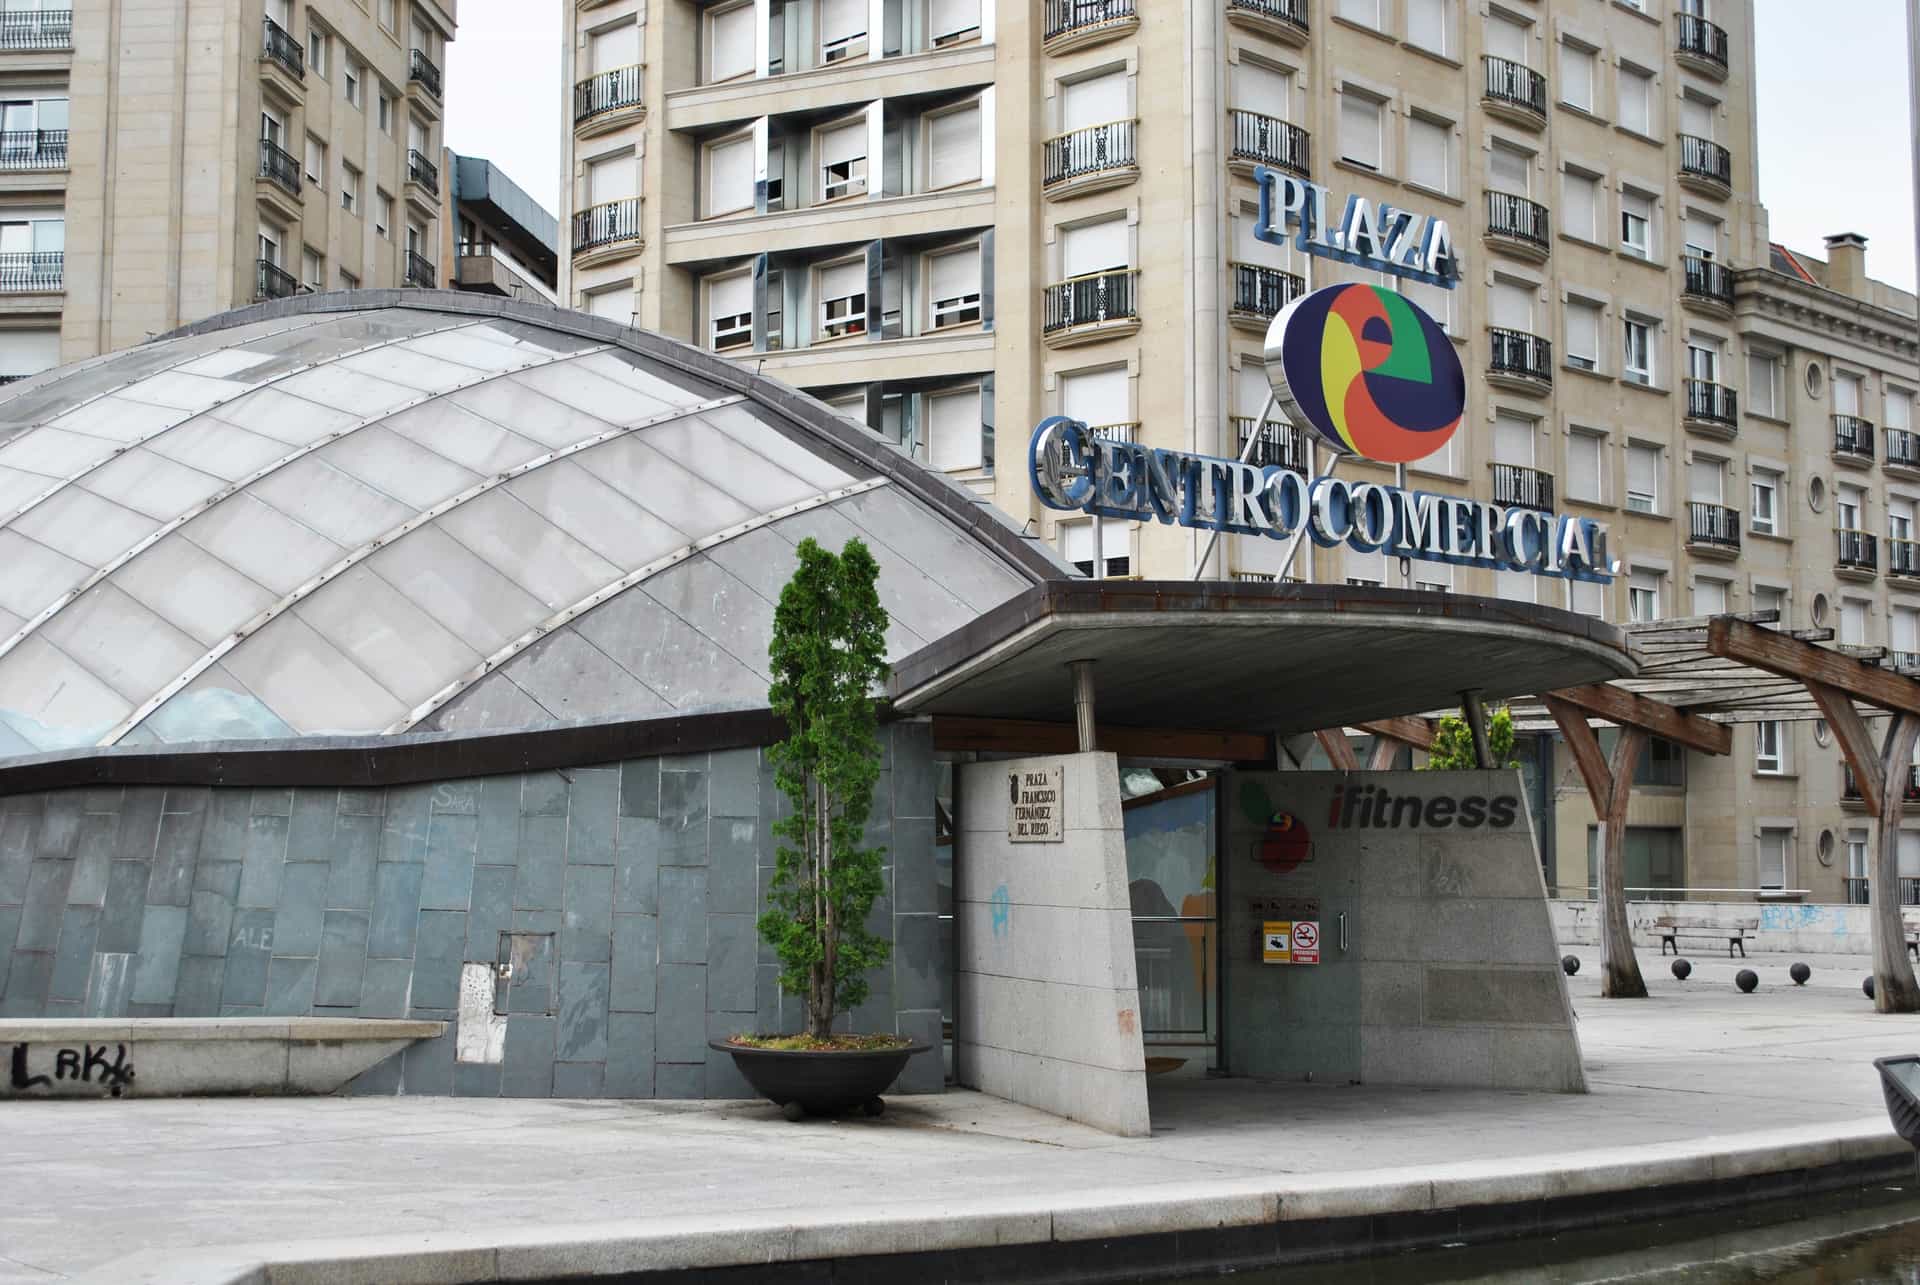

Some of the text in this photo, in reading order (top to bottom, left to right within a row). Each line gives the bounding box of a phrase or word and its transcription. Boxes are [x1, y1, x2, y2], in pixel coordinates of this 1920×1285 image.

[1254, 163, 1463, 289] PLAZA
[1025, 772, 1049, 787] PRAZA
[1022, 789, 1056, 804] FRANCISCO
[1328, 783, 1518, 829] ifitness
[1017, 822, 1049, 836] DEL RIEGO
